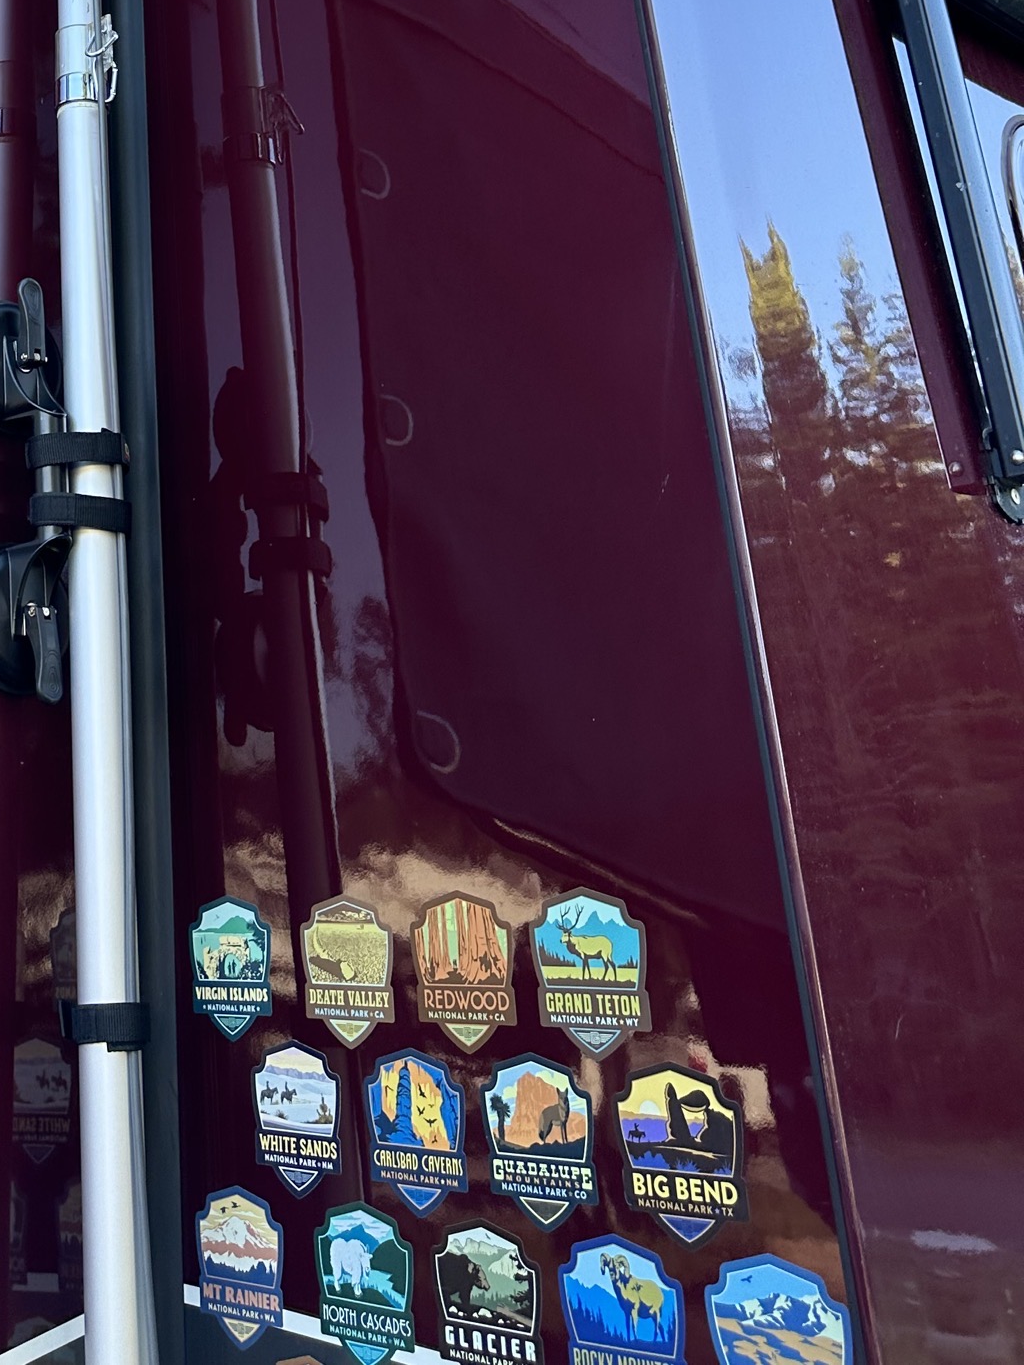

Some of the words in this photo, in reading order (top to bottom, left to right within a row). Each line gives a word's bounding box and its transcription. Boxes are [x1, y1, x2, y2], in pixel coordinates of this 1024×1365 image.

[195, 986, 228, 1000] VIRGIN
[229, 987, 269, 1002] ISLANDS
[309, 988, 345, 1006] DEATH
[347, 990, 390, 1008] VALLEY
[423, 989, 510, 1011] REDWOOD
[207, 1003, 238, 1012] NATIONAL
[239, 1004, 256, 1013] PARK
[314, 1007, 349, 1017] NATIONAL
[350, 1009, 369, 1018] PARK
[374, 1010, 385, 1019] CA
[545, 992, 593, 1014] GRAND
[596, 994, 641, 1017] TETON
[428, 1010, 467, 1020] NATIONAL
[468, 1012, 488, 1021] PARK
[494, 1013, 506, 1022] CA
[550, 1014, 594, 1025] NATIONAL
[595, 1016, 618, 1026] PARK
[625, 1017, 639, 1027] WY
[259, 1133, 297, 1154] WHITE
[299, 1137, 338, 1160] SANDS
[264, 1153, 298, 1165] NATIONAL
[298, 1157, 317, 1168] PARK
[321, 1161, 334, 1170] NM
[373, 1149, 419, 1171] CARLSBAD
[421, 1154, 464, 1176] CAVERNS
[380, 1170, 418, 1183] NATIONAL
[420, 1174, 440, 1185] PARK
[446, 1178, 459, 1187] NM
[492, 1158, 593, 1191] GUADALUPE
[505, 1174, 580, 1189] MOUNTAINS
[501, 1182, 544, 1195] NATIONAL
[545, 1186, 568, 1198] PARK
[574, 1190, 587, 1200] CO
[632, 1172, 670, 1198] BIG
[675, 1176, 738, 1205] BEND
[638, 1198, 686, 1212] NATIONAL
[688, 1203, 714, 1215] PARK
[721, 1207, 734, 1217] TX
[202, 1282, 222, 1301] MT
[225, 1286, 281, 1312] RAINIER
[207, 1302, 241, 1316] NATIONAL
[242, 1308, 259, 1320] PARK
[264, 1313, 276, 1323] WA
[322, 1303, 357, 1326] NORTH
[360, 1311, 412, 1337] CASCADES
[329, 1324, 366, 1339] NATIONAL
[367, 1332, 388, 1344] PARK
[393, 1337, 406, 1348] WA
[444, 1325, 536, 1362] GLACIER
[449, 1348, 491, 1365] NATIONAL
